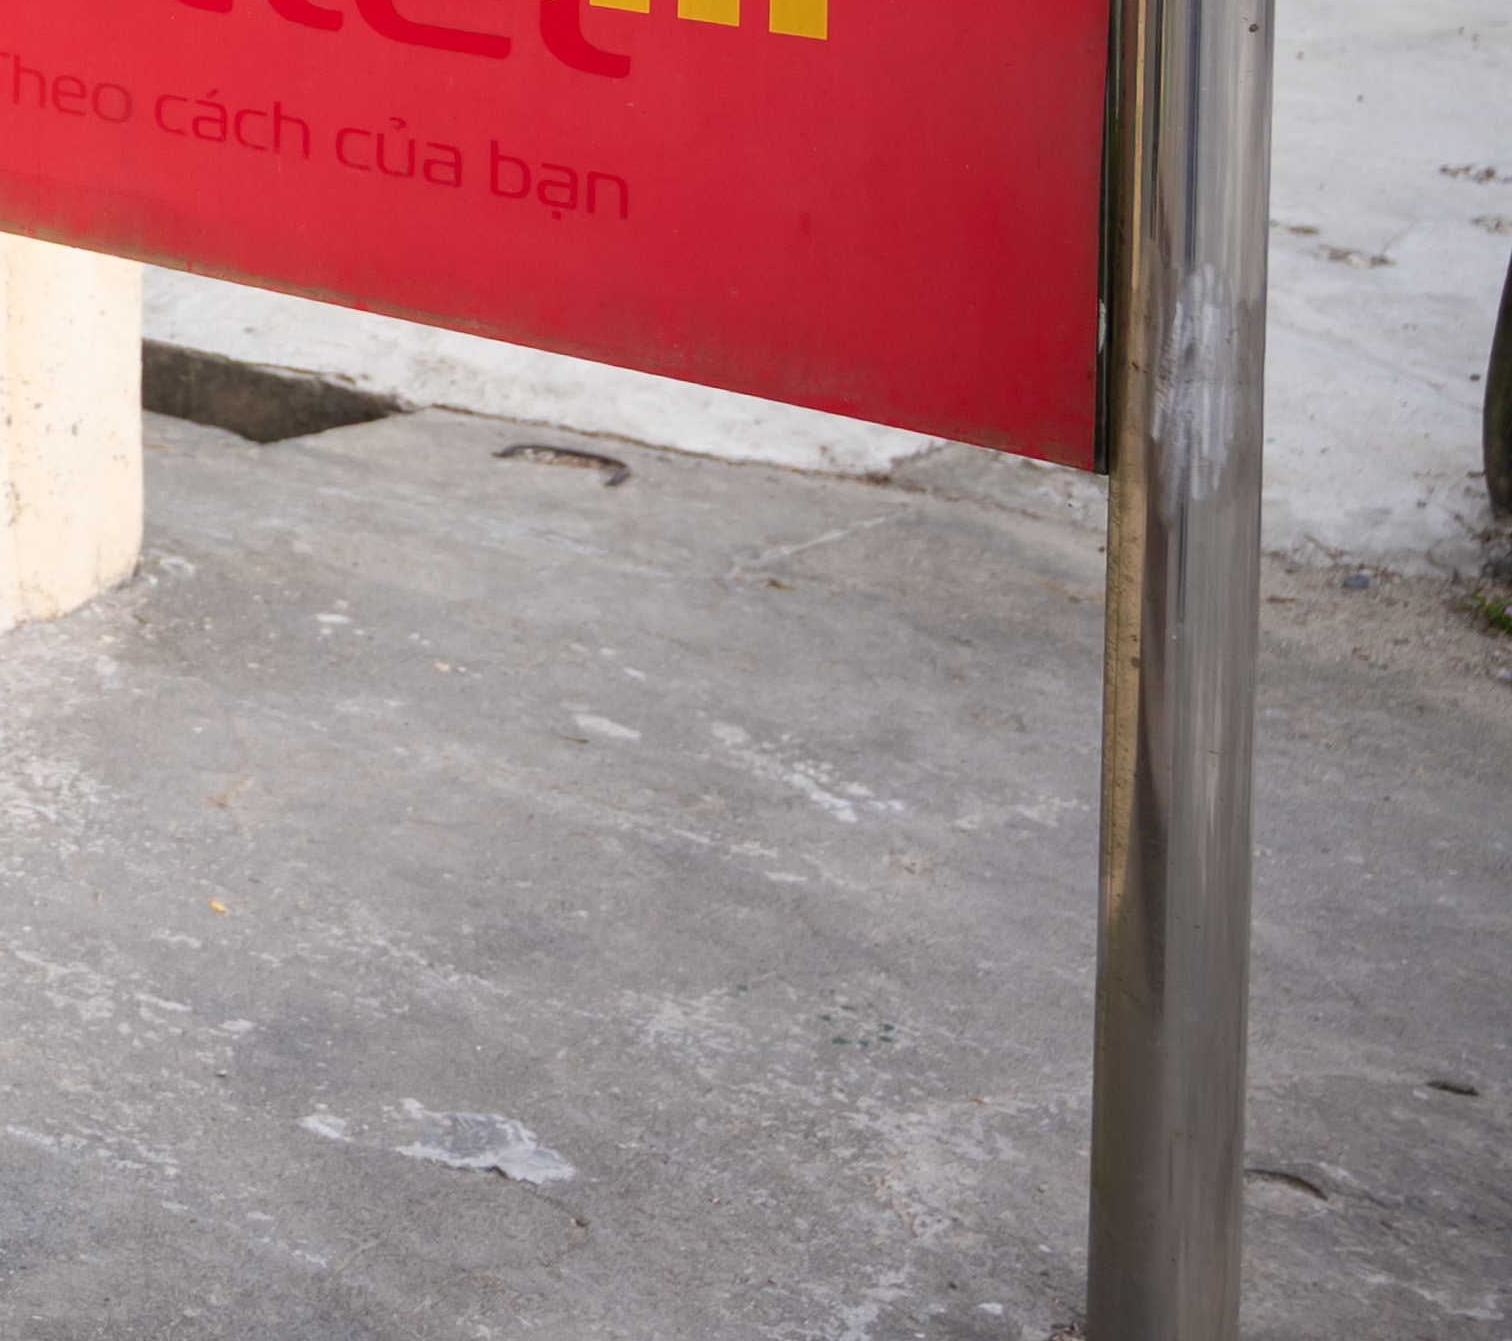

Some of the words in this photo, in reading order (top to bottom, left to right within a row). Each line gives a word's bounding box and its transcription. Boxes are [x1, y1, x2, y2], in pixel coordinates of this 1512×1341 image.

[154, 88, 310, 161] cách
[334, 118, 463, 188] của
[489, 140, 629, 221] bạn
